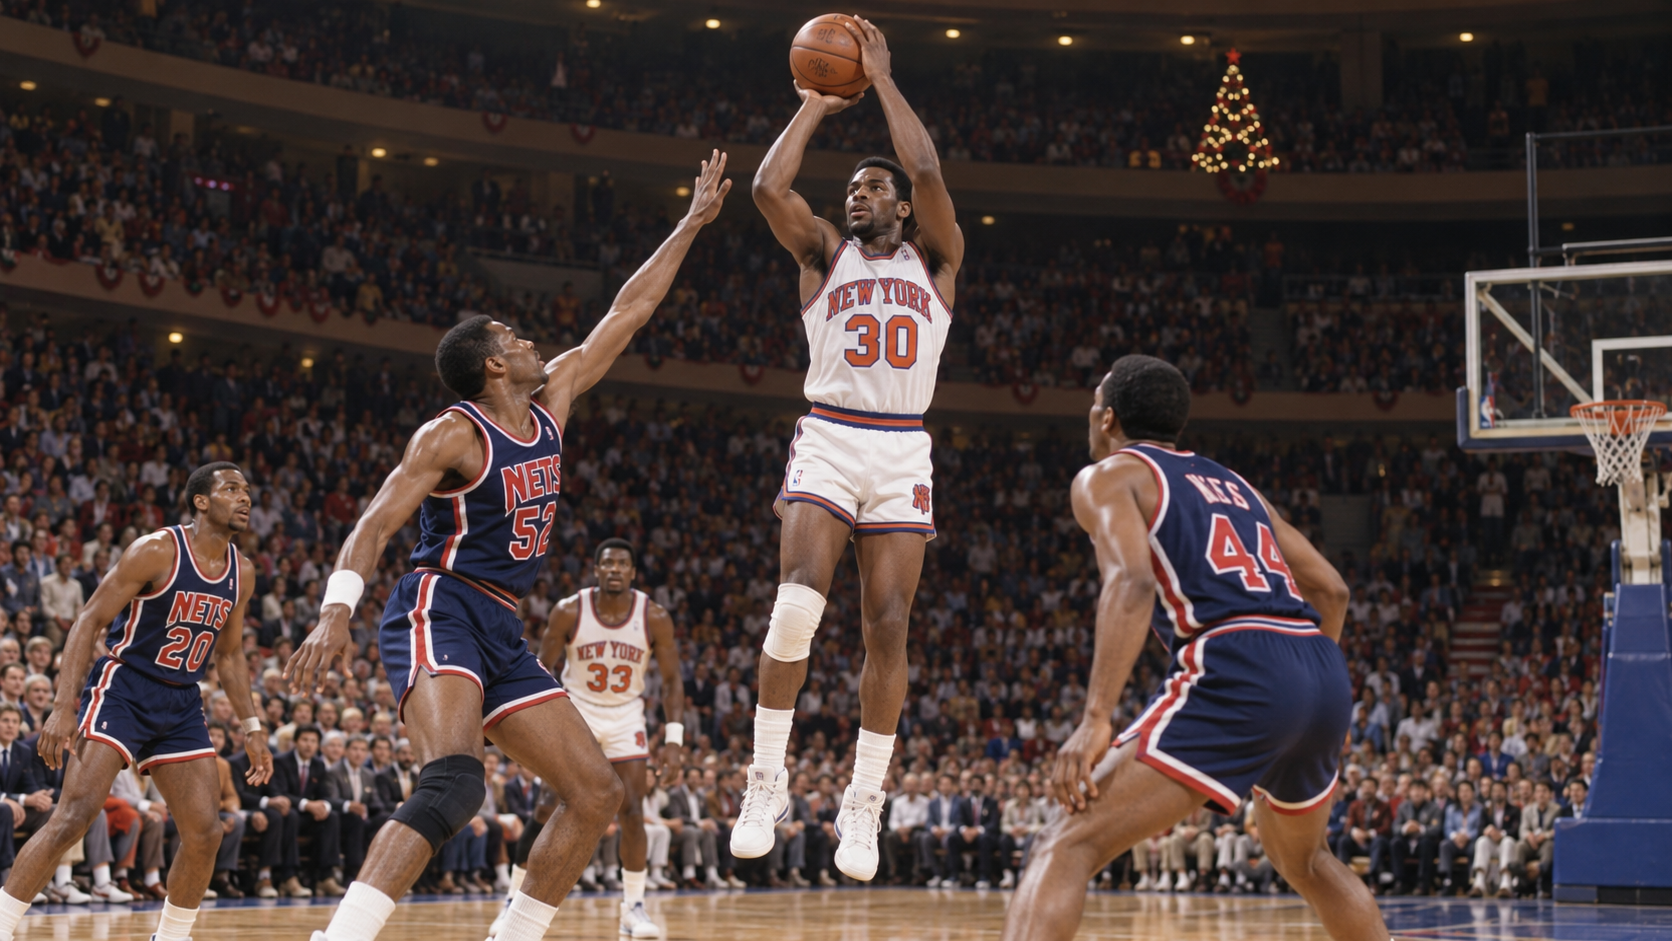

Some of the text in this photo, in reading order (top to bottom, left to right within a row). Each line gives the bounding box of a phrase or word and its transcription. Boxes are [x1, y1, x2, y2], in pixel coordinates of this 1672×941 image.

[826, 277, 932, 324] NEW YORK
[844, 314, 918, 370] 30
[500, 454, 561, 517] NETS
[508, 501, 557, 560] 52
[1205, 512, 1304, 602] 44
[165, 590, 233, 631] NETS
[154, 626, 214, 672] 20
[577, 641, 645, 664] NEW YORK
[586, 663, 632, 693] 33
